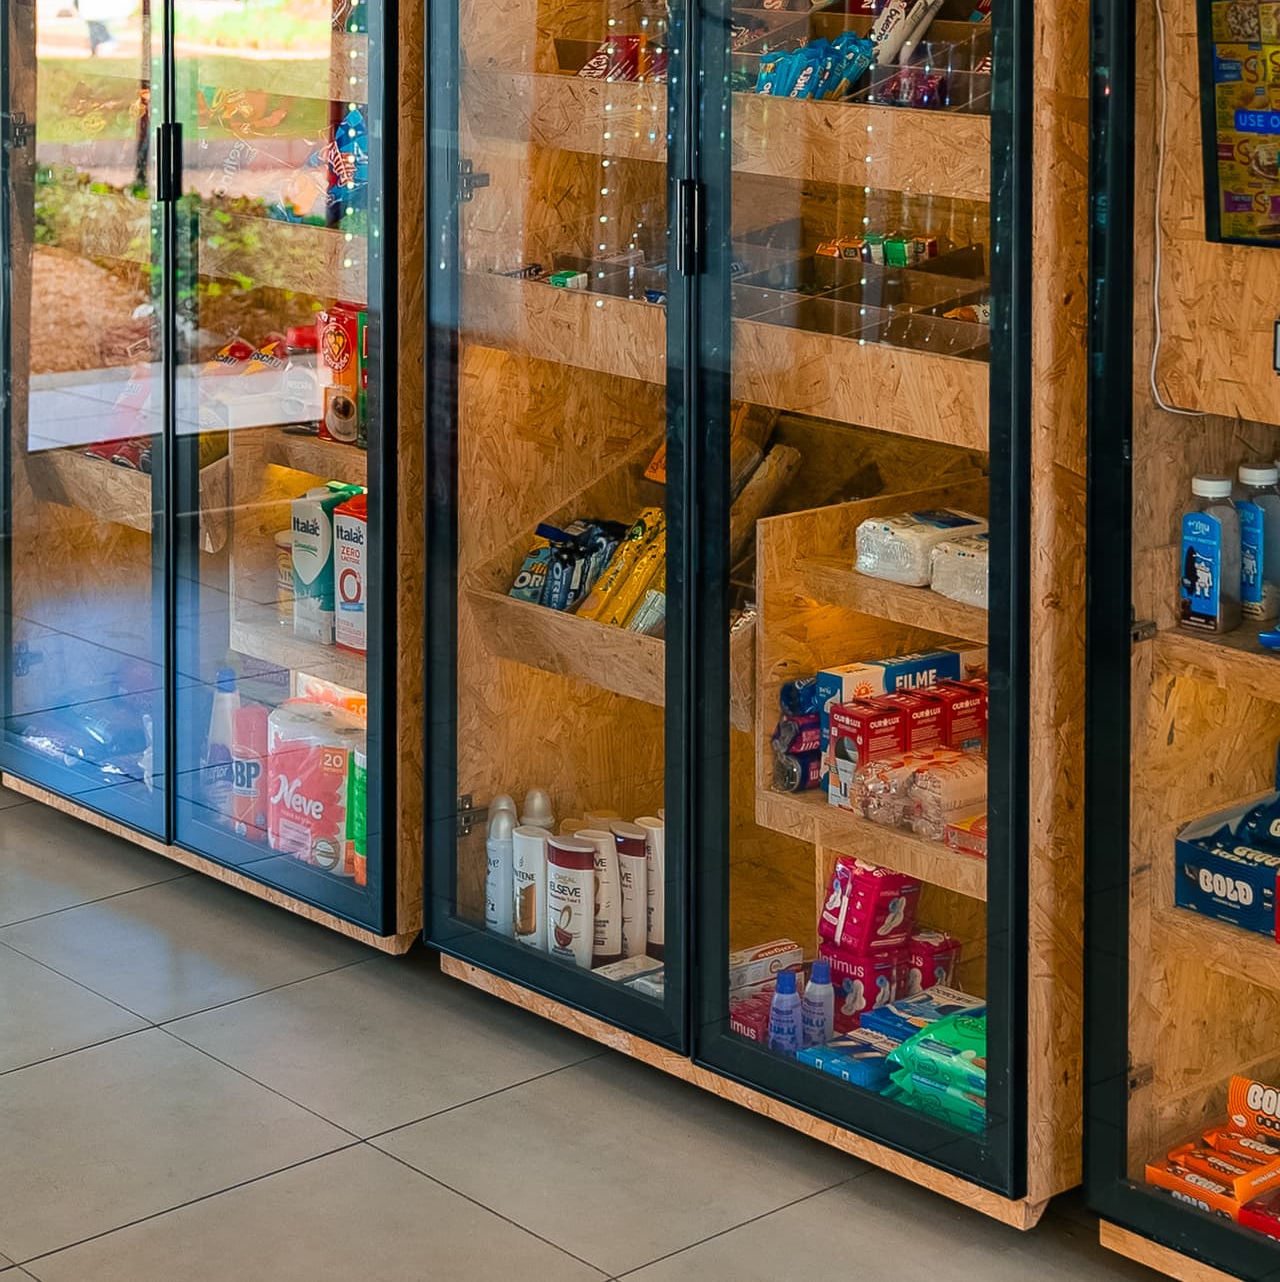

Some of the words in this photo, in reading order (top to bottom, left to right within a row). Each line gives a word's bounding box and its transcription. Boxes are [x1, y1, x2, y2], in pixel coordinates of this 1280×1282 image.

[1238, 113, 1265, 128] USE
[1269, 115, 1280, 129] O
[293, 516, 321, 537] Italac
[336, 525, 364, 546] Italac
[340, 545, 361, 559] ZERO
[894, 668, 938, 693] FILME
[323, 752, 343, 768] 20
[271, 773, 325, 820] Neve
[549, 881, 581, 898] ELSEVE
[1198, 867, 1254, 906] BOLD
